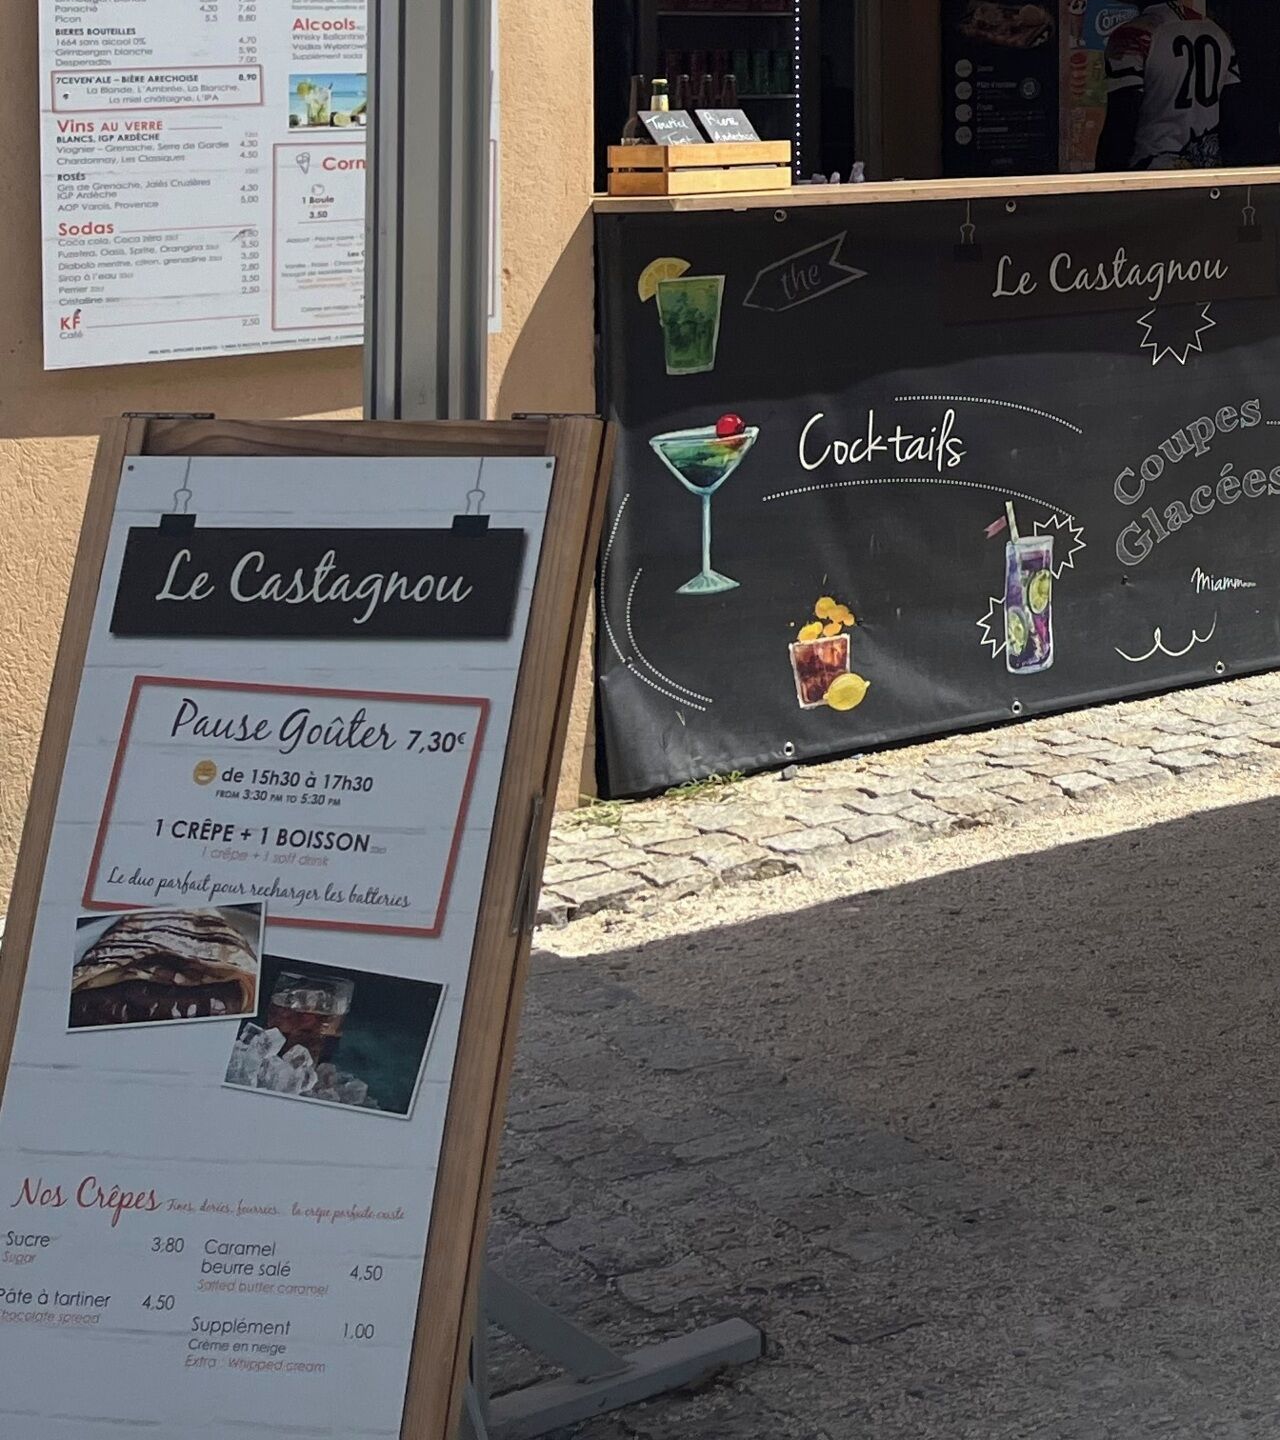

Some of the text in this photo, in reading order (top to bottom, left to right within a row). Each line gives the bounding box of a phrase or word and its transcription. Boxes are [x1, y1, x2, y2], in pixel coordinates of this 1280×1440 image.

[292, 17, 356, 32] Alcools
[1172, 34, 1222, 109] 20
[57, 120, 163, 133] Vins AU VERRE
[58, 221, 114, 236] Sodas
[781, 260, 822, 301] the
[993, 247, 1229, 301] Le Castagnou
[60, 316, 82, 331] KF
[799, 409, 967, 472] Cocktails
[1113, 398, 1262, 506] Coupes
[155, 549, 474, 625] Le Castagnou
[171, 698, 467, 754] Pause Goûter 7,30€
[221, 768, 374, 792] de 15h30 à 17h30
[242, 789, 268, 801] 3:30
[300, 793, 326, 806] 5:30
[155, 817, 370, 853] 1 CRÊPE + 1 BOISSON
[107, 866, 411, 908] Le duo parfait pour recharger les batteries
[10, 1177, 68, 1208] Nos
[76, 1175, 162, 1228] Crêpes
[5, 1231, 51, 1247] Sucre
[204, 1240, 276, 1257] Caramel
[201, 1260, 292, 1277] beurre salé
[37, 1289, 49, 1306] à
[54, 1290, 112, 1308] tartiner
[191, 1317, 292, 1338] Supplément
[188, 1339, 287, 1356] Crème en neige
